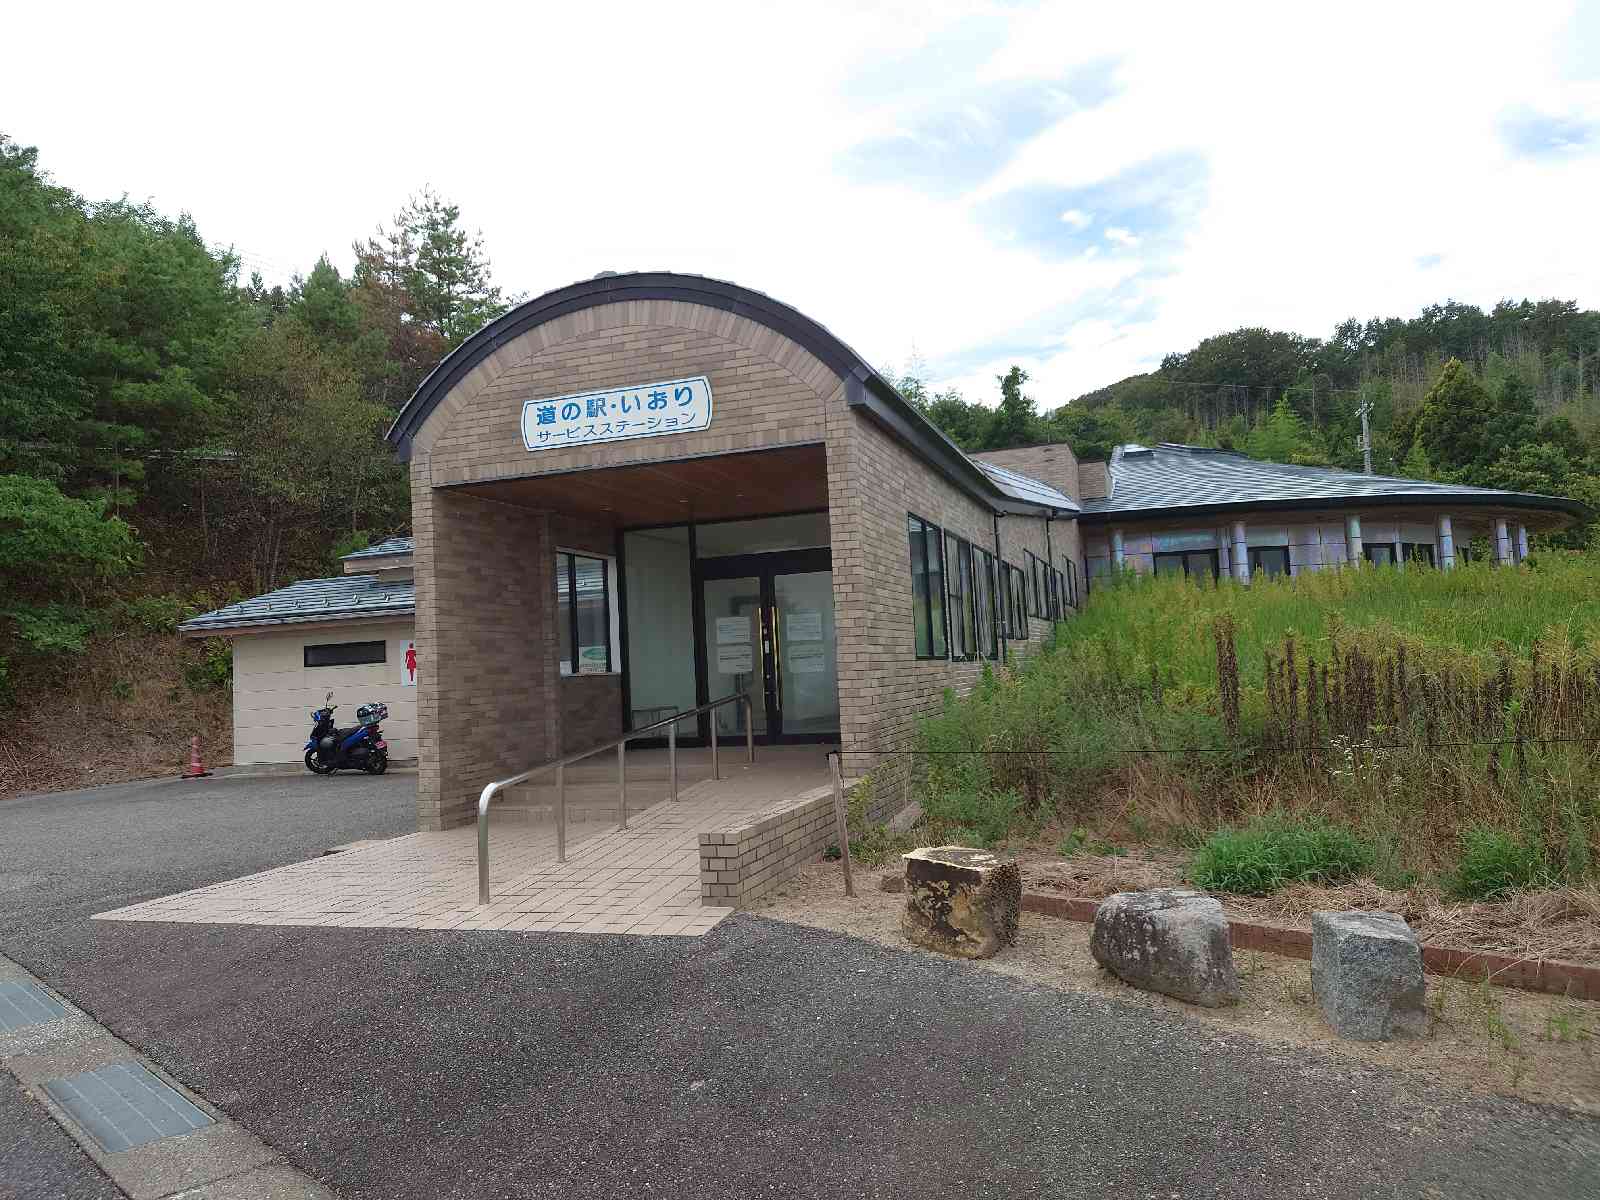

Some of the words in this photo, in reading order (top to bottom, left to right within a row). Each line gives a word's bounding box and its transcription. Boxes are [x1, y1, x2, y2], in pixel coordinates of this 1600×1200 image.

[536, 386, 693, 426] 道の駅・いおり
[536, 412, 696, 443] サービスステーション
